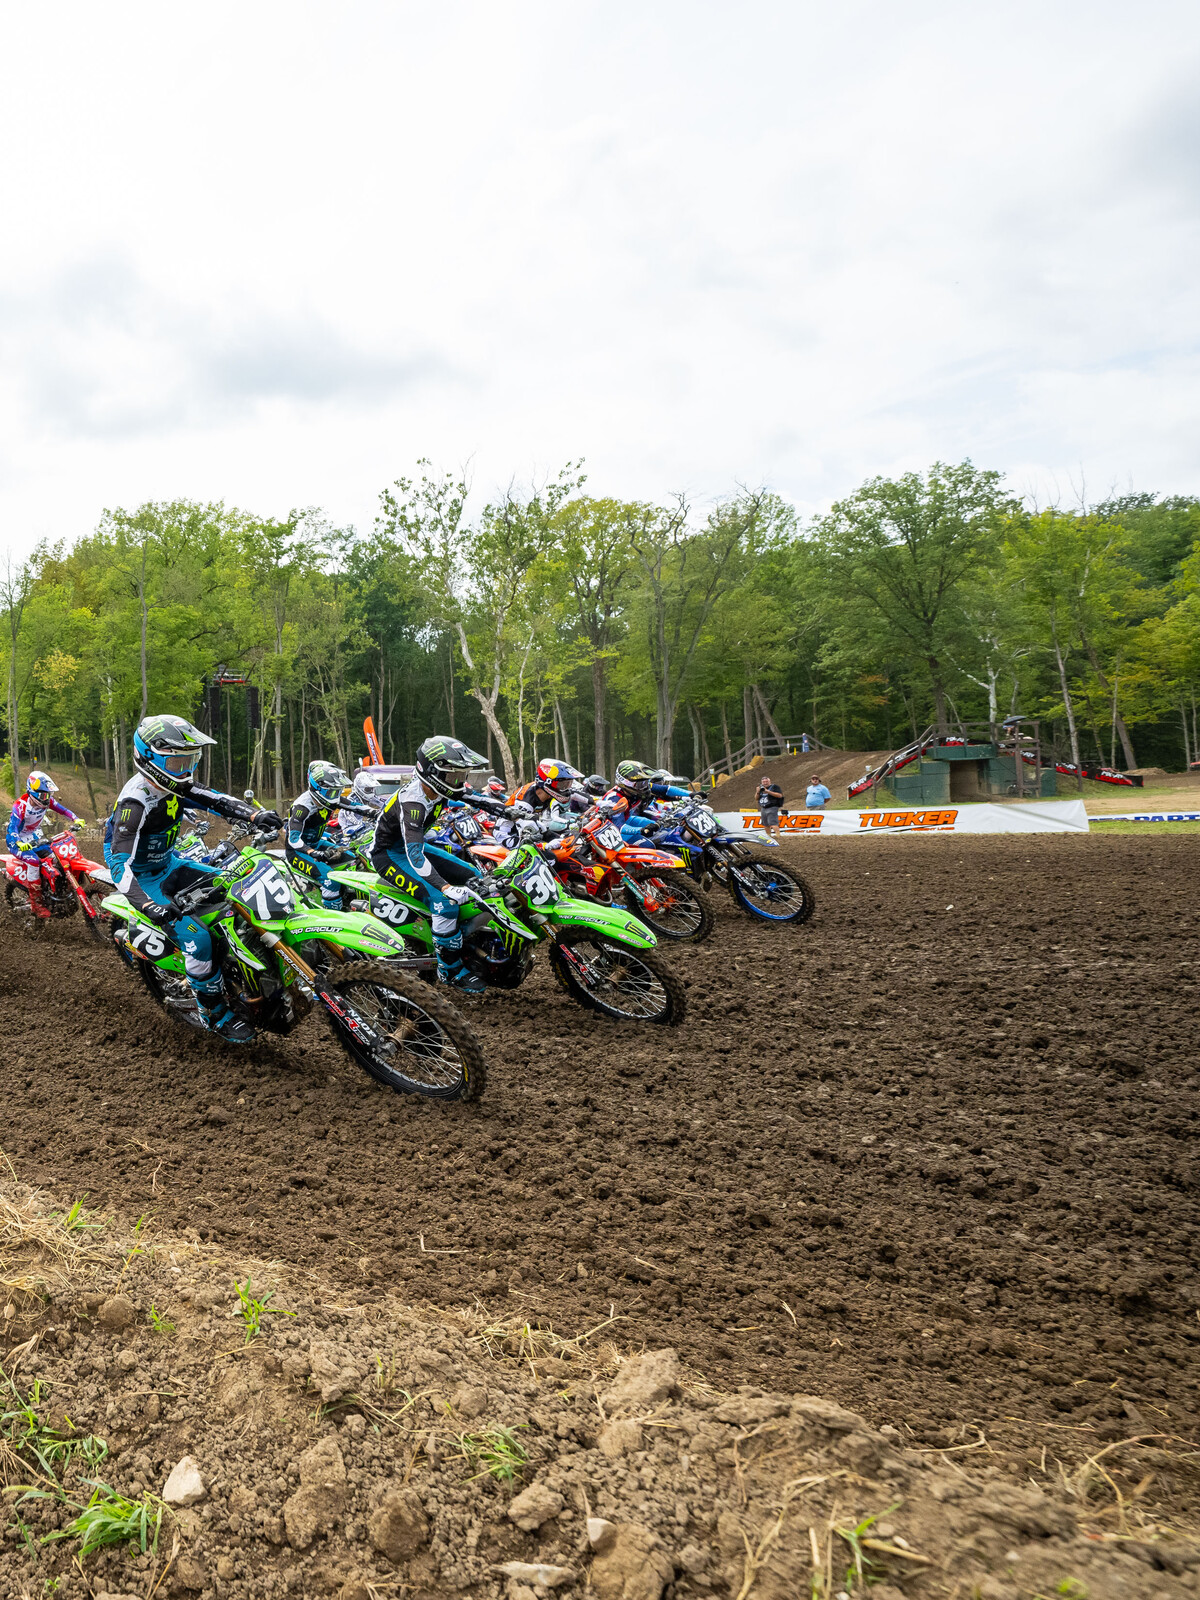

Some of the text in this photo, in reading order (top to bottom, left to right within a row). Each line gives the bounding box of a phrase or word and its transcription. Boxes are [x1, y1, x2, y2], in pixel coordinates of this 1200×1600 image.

[742, 814, 825, 829] TUKER
[858, 809, 959, 828] TUCKER
[57, 841, 79, 858] 96
[13, 865, 28, 882] 96
[292, 857, 313, 876] FOX
[384, 865, 420, 897] FOX
[524, 863, 557, 906] 30
[240, 865, 291, 920] 75
[148, 904, 169, 918] FOX
[372, 898, 410, 924] 30
[305, 926, 344, 934] CIRCUIT
[132, 925, 167, 957] 75
[277, 949, 291, 964] PRO
